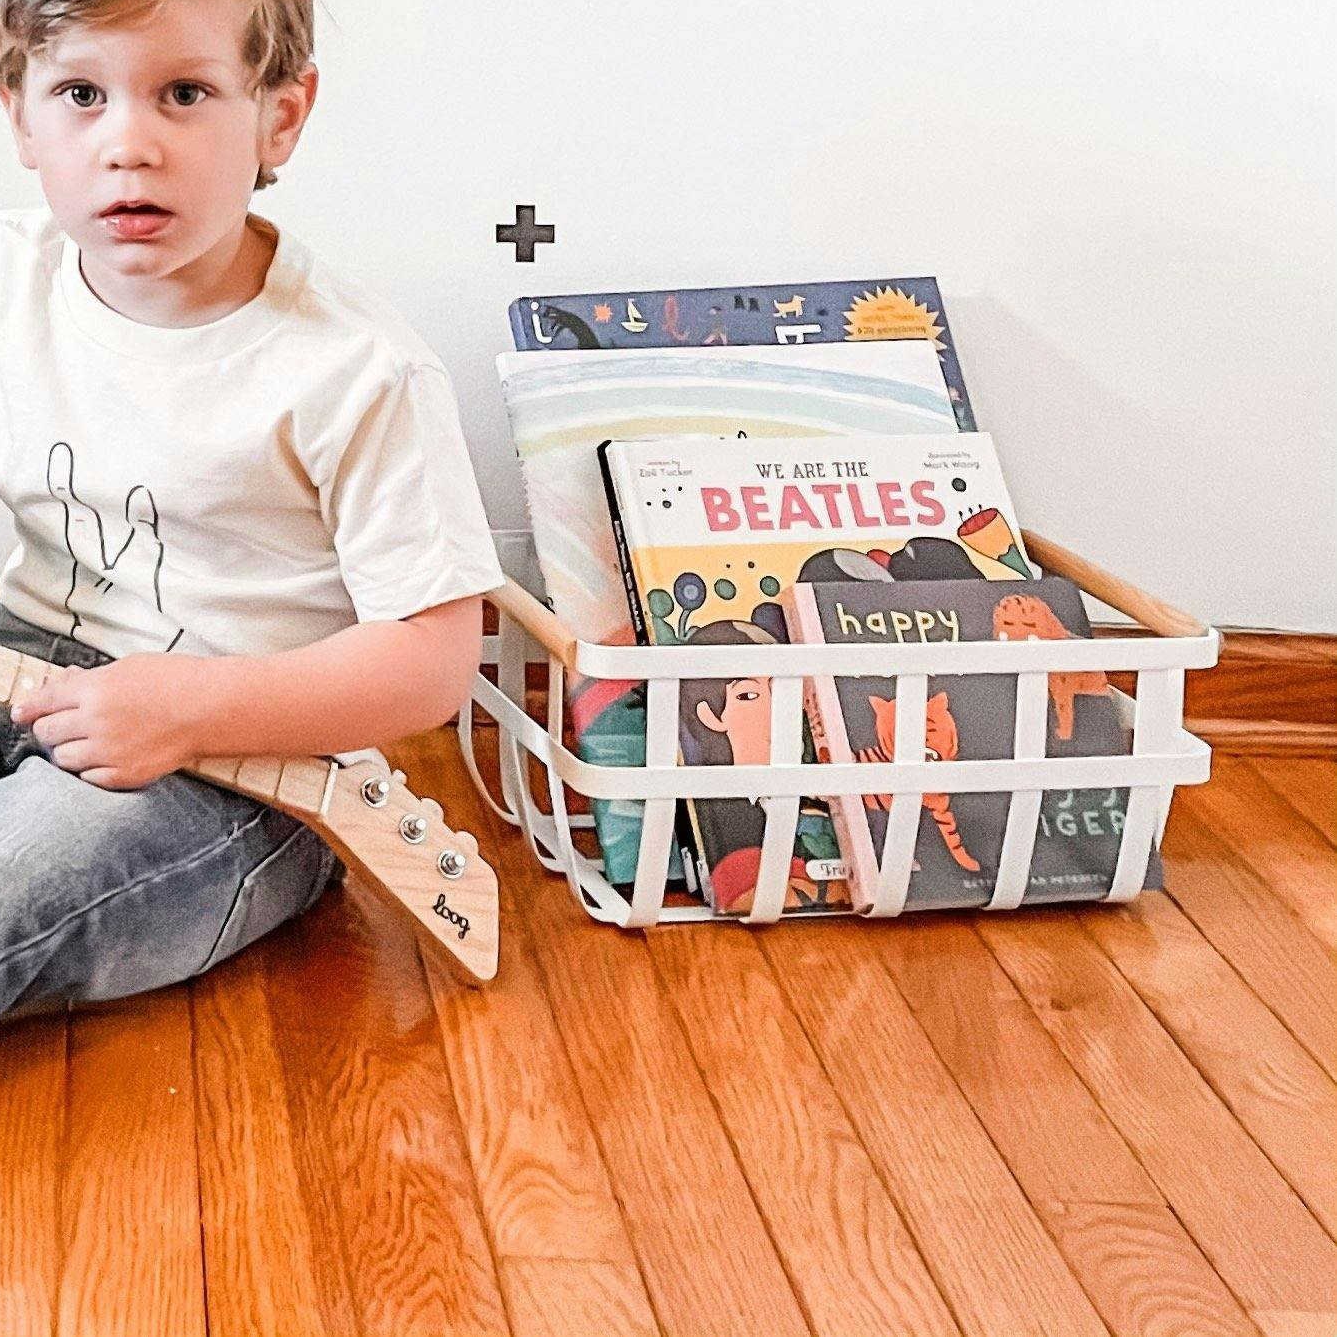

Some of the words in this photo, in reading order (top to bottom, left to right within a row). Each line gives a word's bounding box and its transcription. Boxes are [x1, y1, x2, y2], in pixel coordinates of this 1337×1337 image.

[755, 462, 784, 480] WE
[792, 461, 826, 479] ARE
[831, 460, 869, 478] THE
[700, 480, 946, 532] BEATLES
[836, 602, 959, 643] happy
[1040, 809, 1127, 838] IGER
[431, 892, 471, 940] loog
